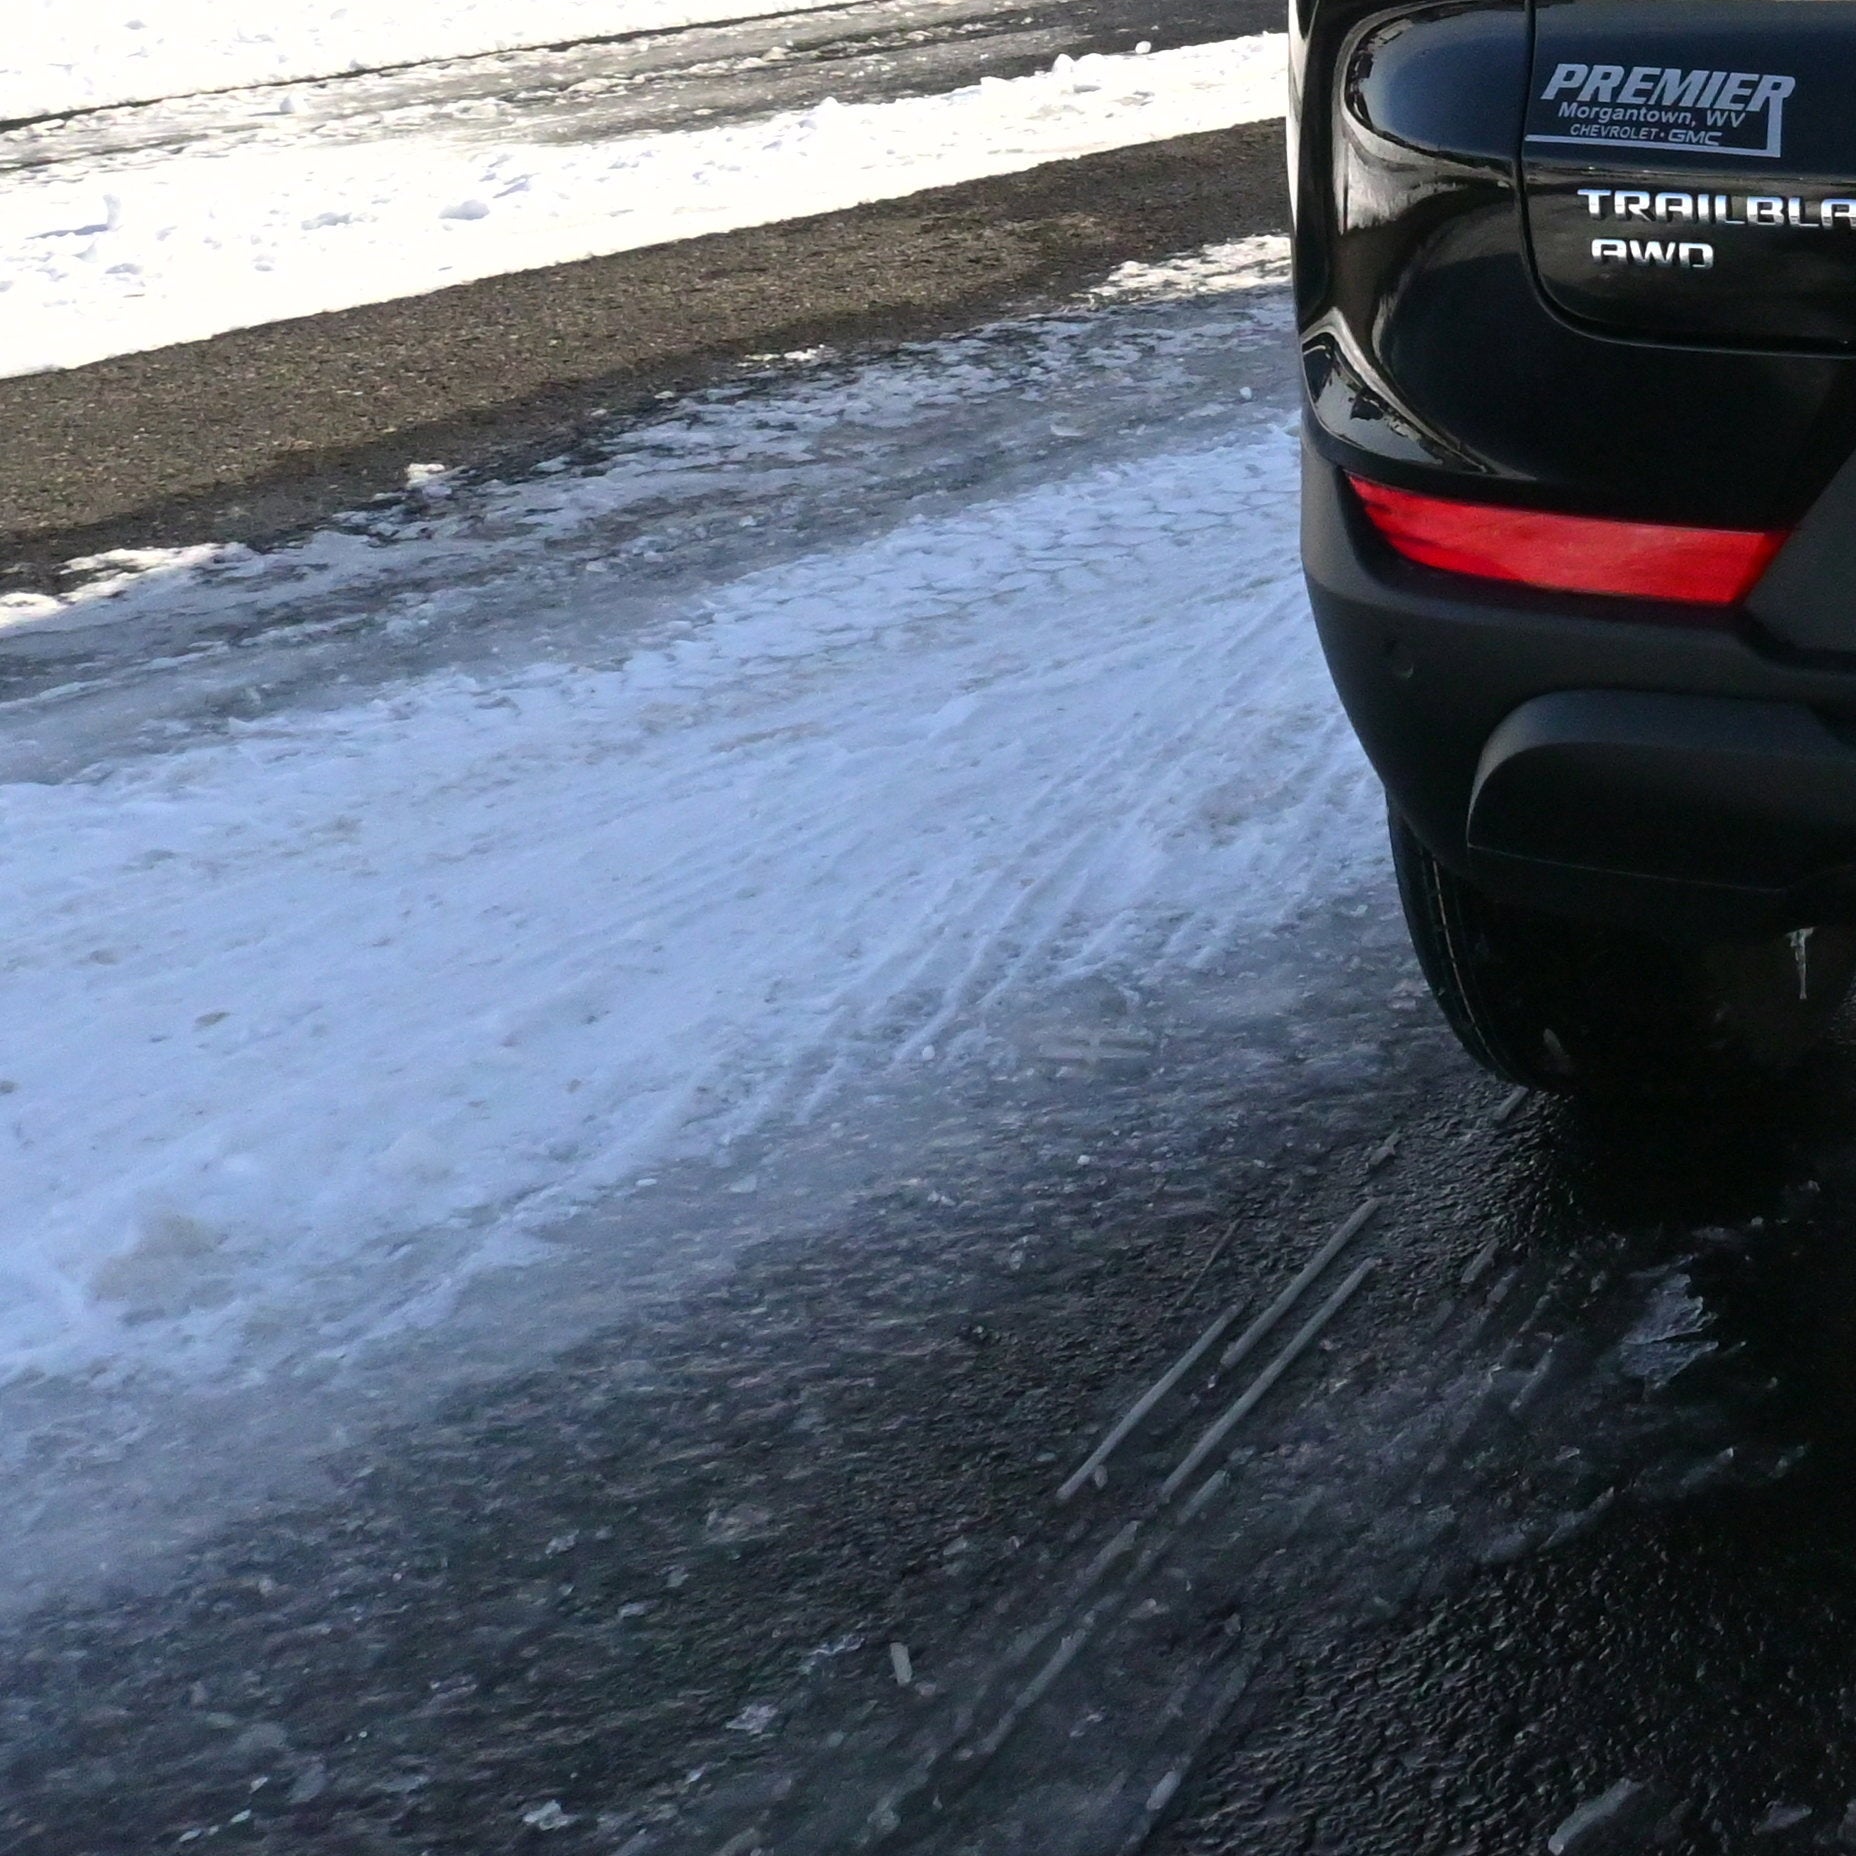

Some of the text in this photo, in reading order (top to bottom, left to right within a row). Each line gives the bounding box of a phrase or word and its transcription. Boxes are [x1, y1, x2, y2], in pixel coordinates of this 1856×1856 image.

[1540, 62, 1796, 126] PREMIER
[1558, 101, 1746, 129] Morgantown, WV
[1570, 123, 1723, 147] CHEVROLET GMC
[1591, 238, 1715, 270] AWD
